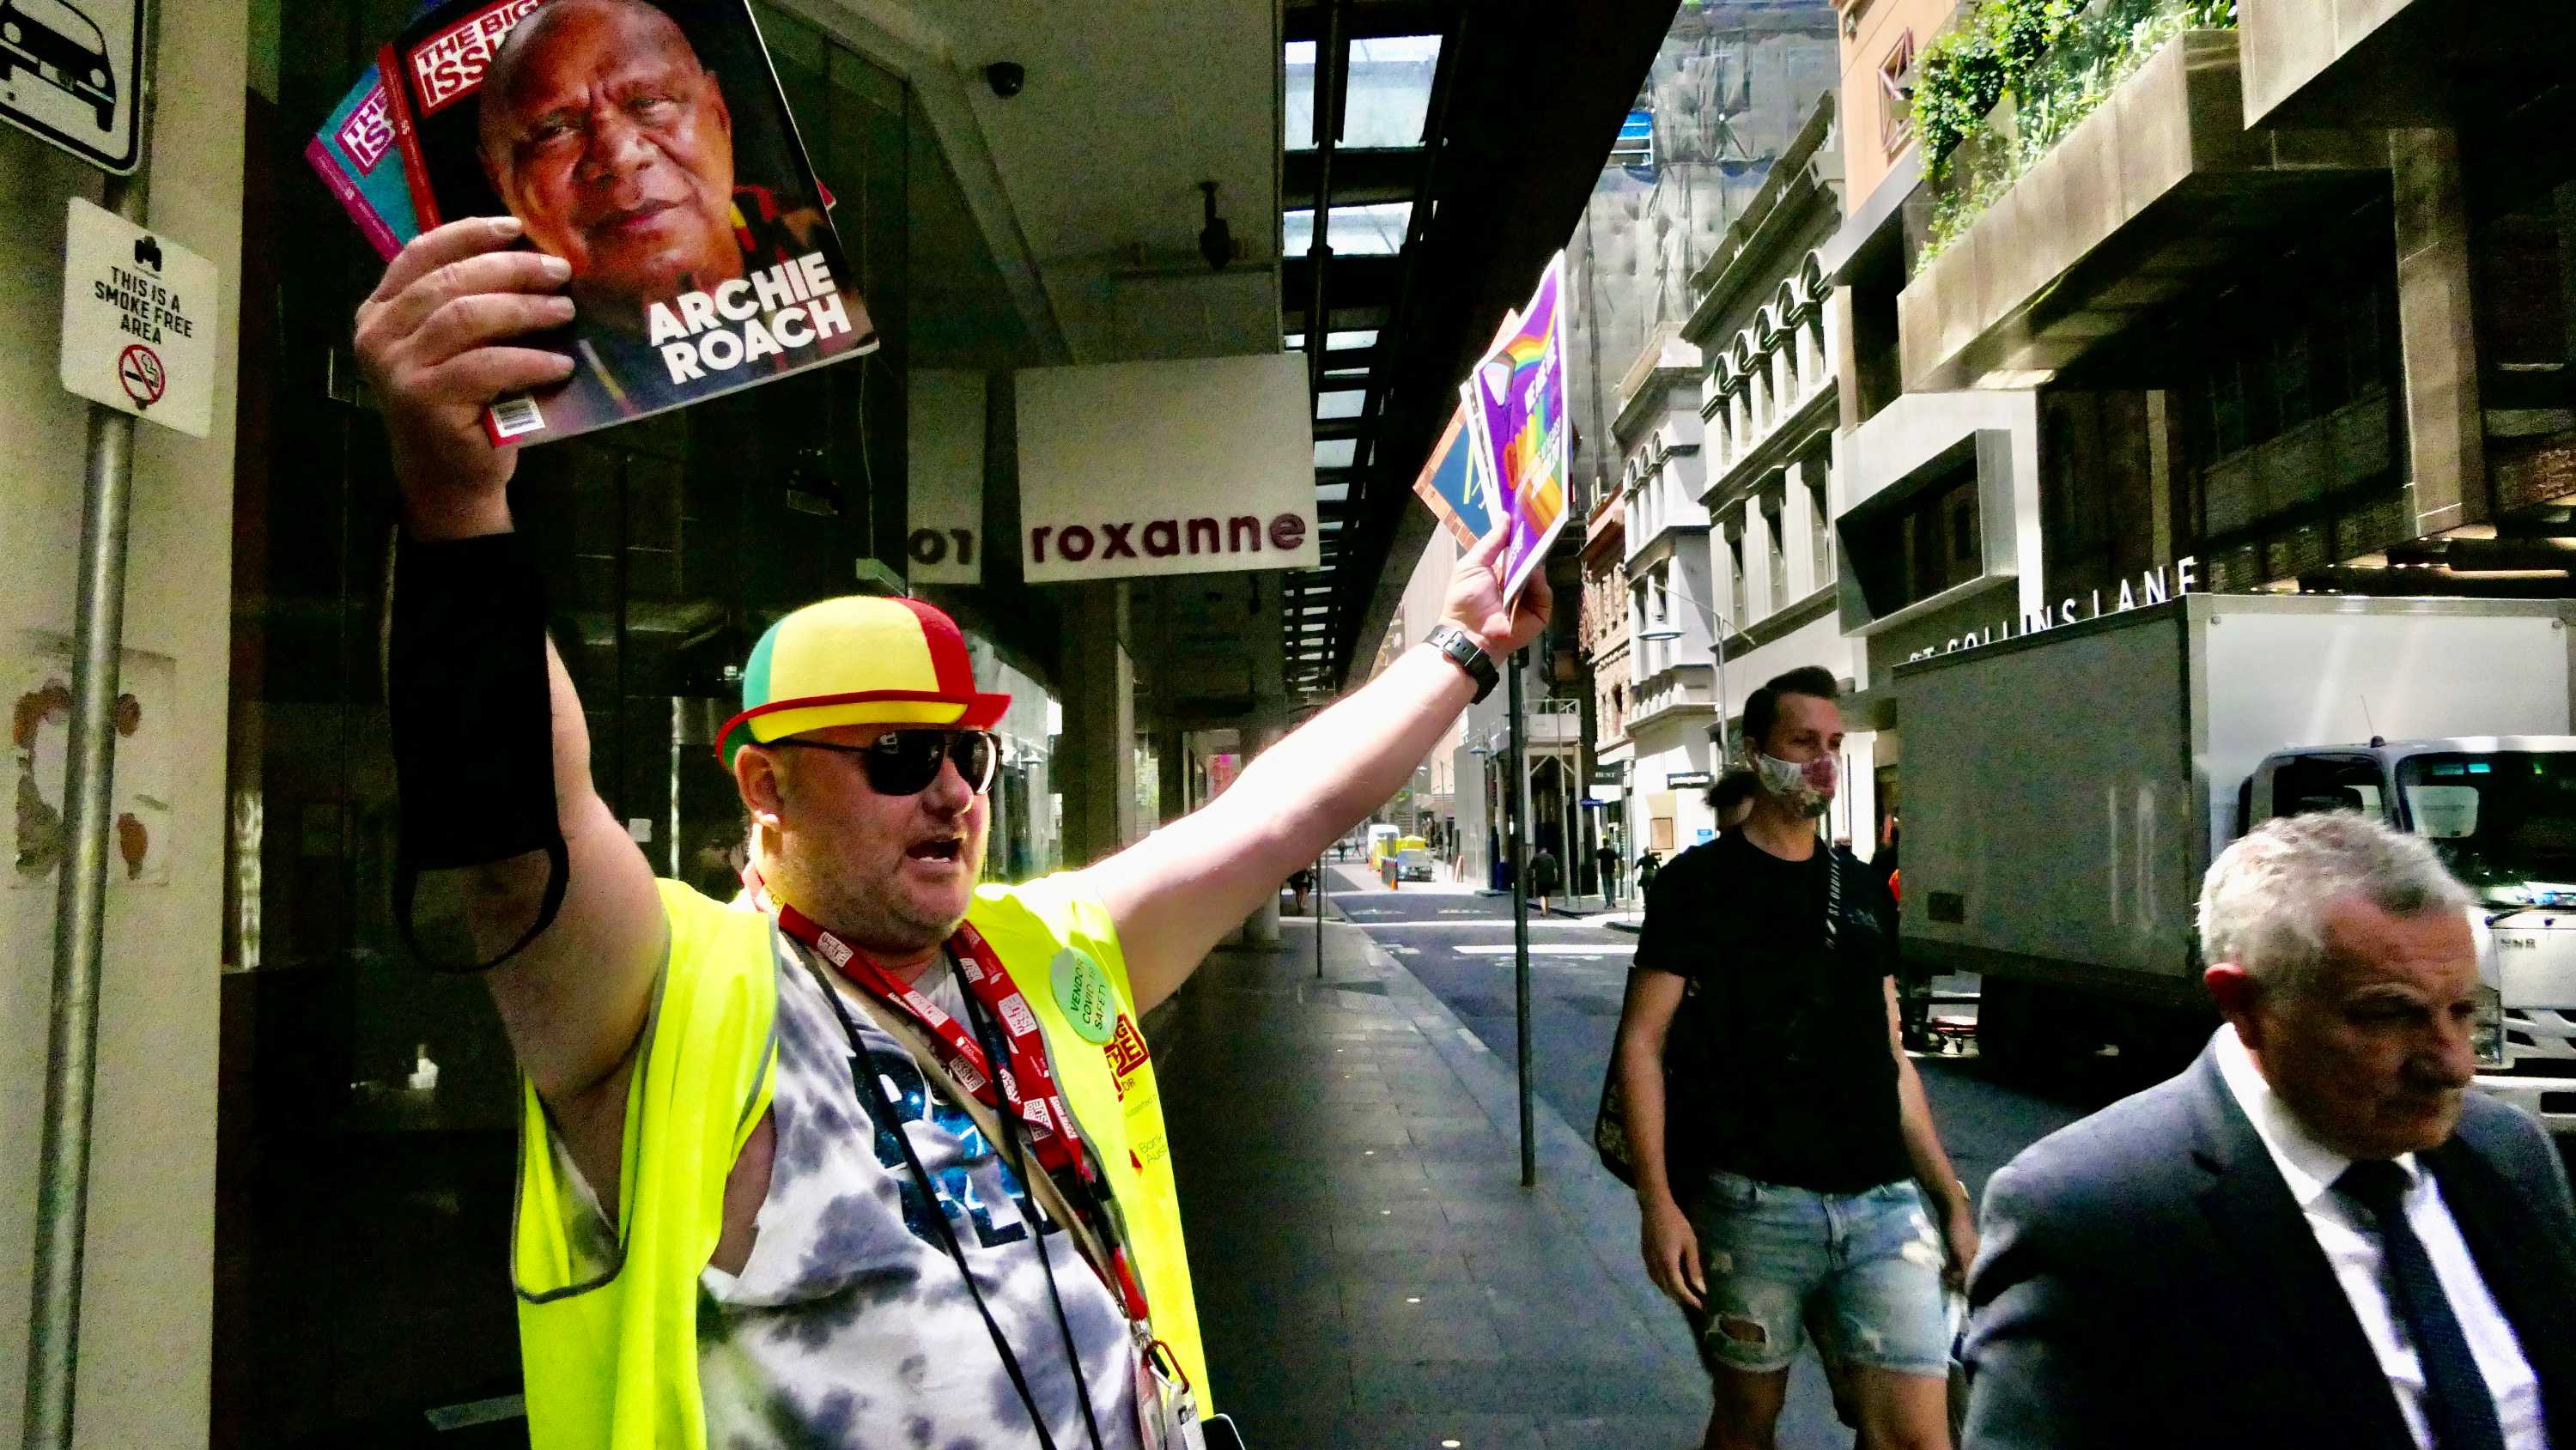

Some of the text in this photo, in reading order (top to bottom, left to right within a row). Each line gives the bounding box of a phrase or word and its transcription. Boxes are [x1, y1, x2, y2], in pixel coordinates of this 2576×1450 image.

[417, 25, 477, 69] THE
[94, 280, 192, 338] SMOKE FREE
[111, 266, 147, 297] THIS
[151, 285, 167, 306] IS
[171, 294, 179, 312] A
[650, 252, 836, 347] ARCHIE
[121, 314, 161, 344] AREA
[661, 294, 852, 385] ROACH
[1031, 513, 1307, 563] roxanne
[1070, 957, 1085, 1013] VENDOR
